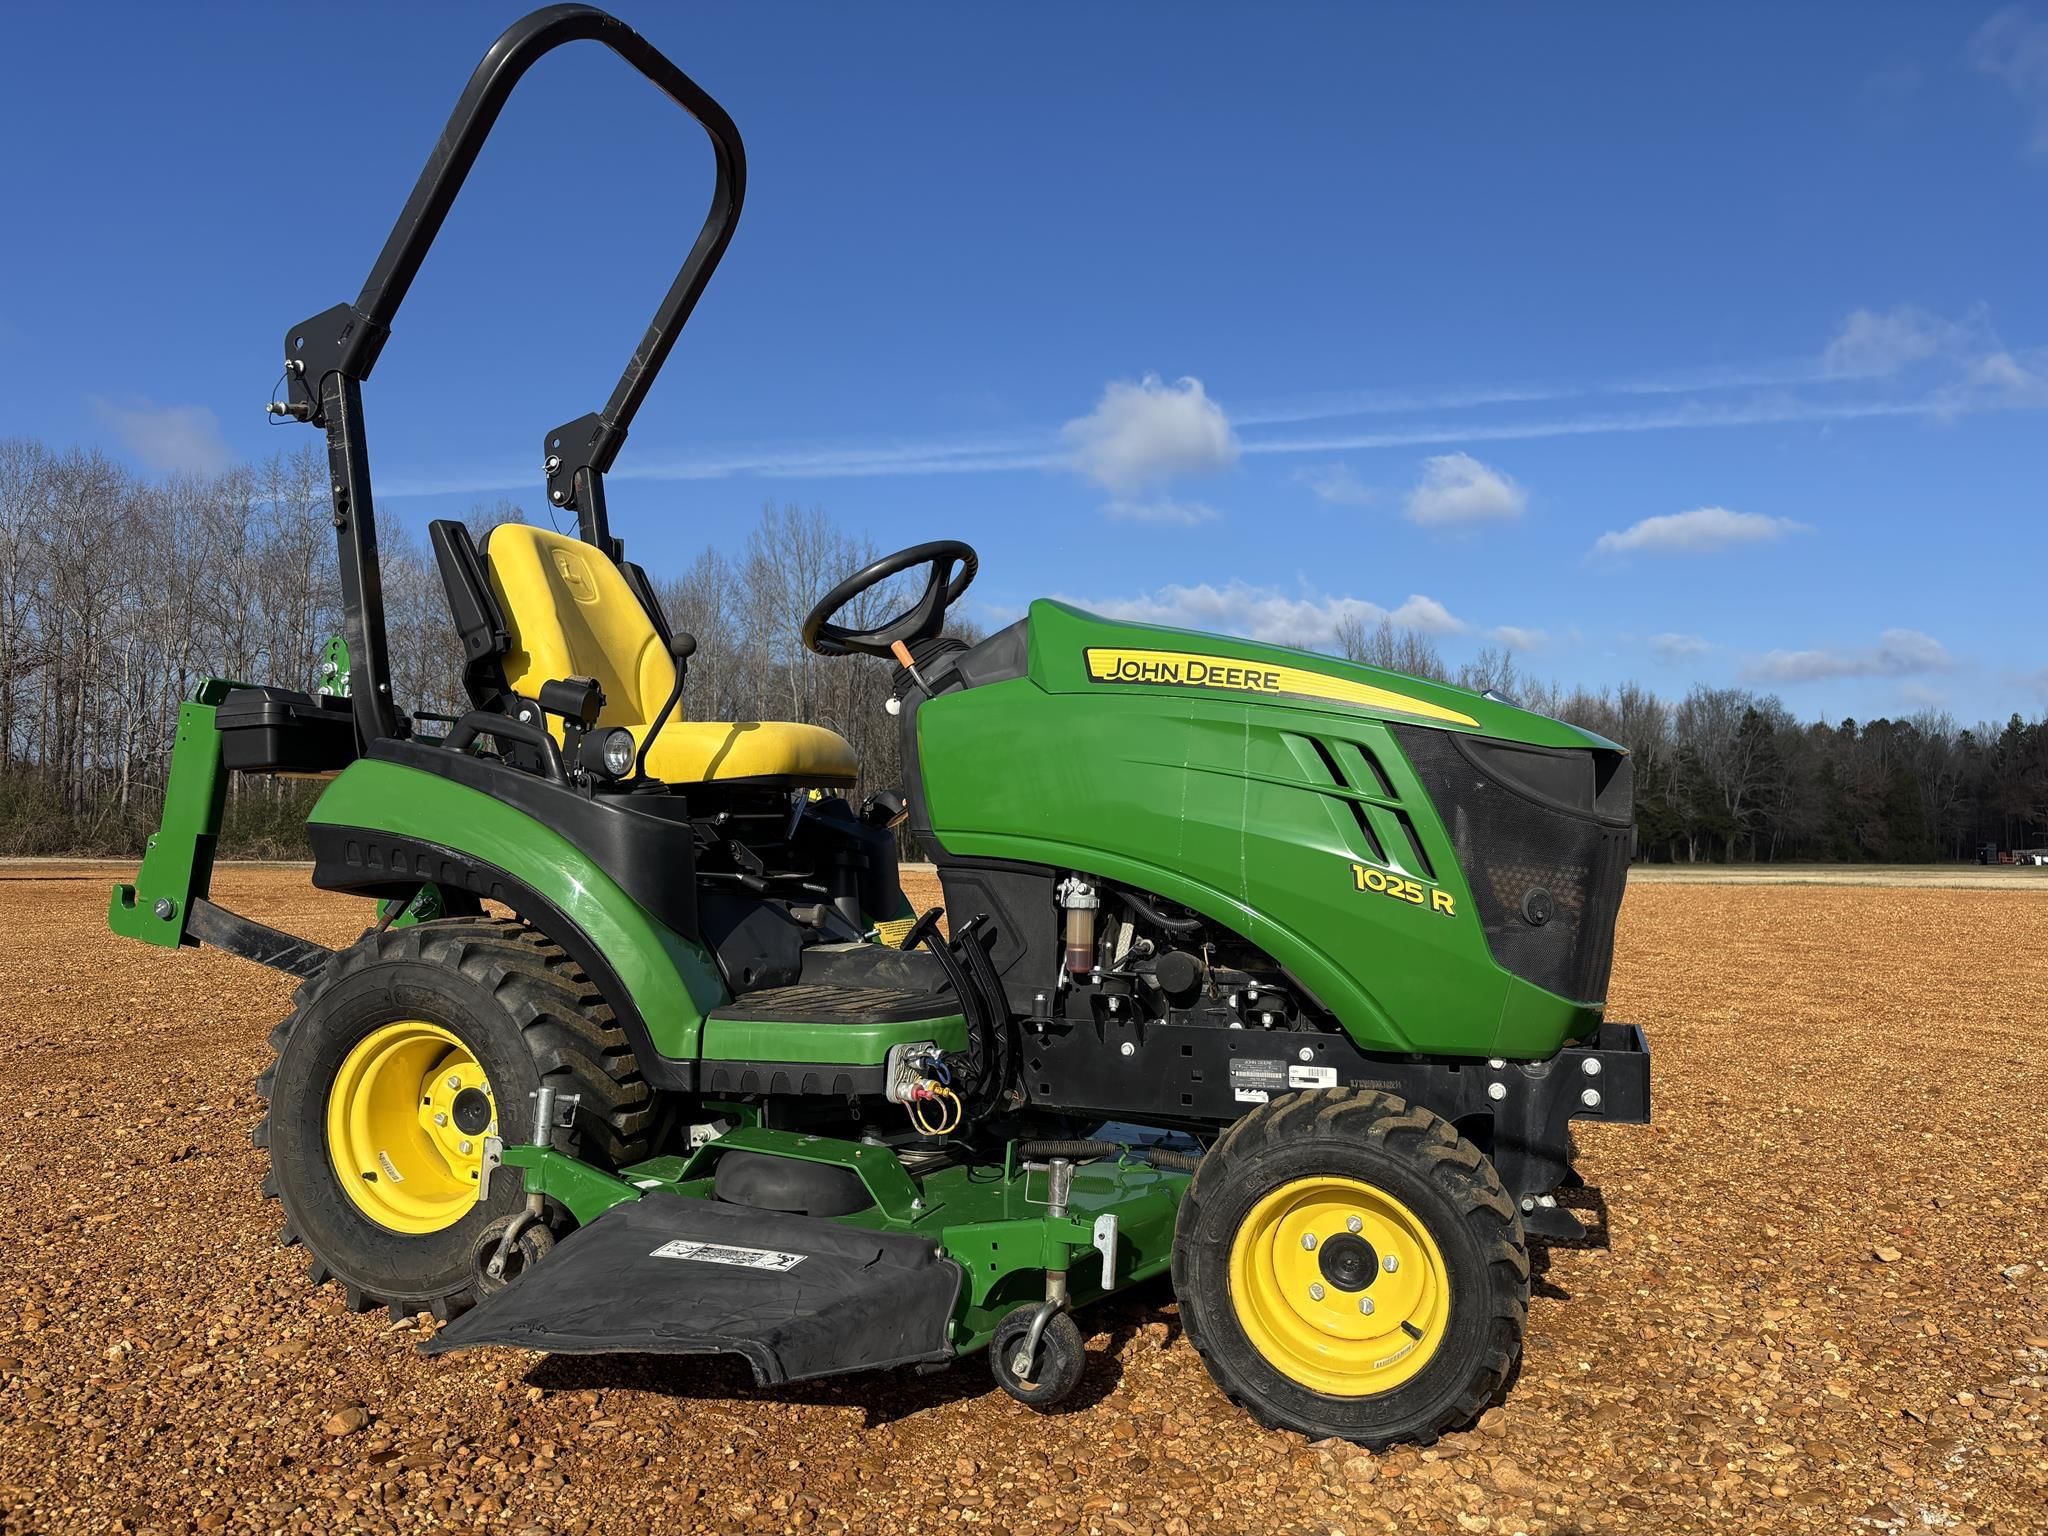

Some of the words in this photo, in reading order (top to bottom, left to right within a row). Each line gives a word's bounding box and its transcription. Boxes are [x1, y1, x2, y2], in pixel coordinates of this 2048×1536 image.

[1105, 657, 1181, 681] JOHN
[1186, 661, 1281, 691] DEERE
[1350, 864, 1425, 905] 1025
[1431, 888, 1457, 917] R
